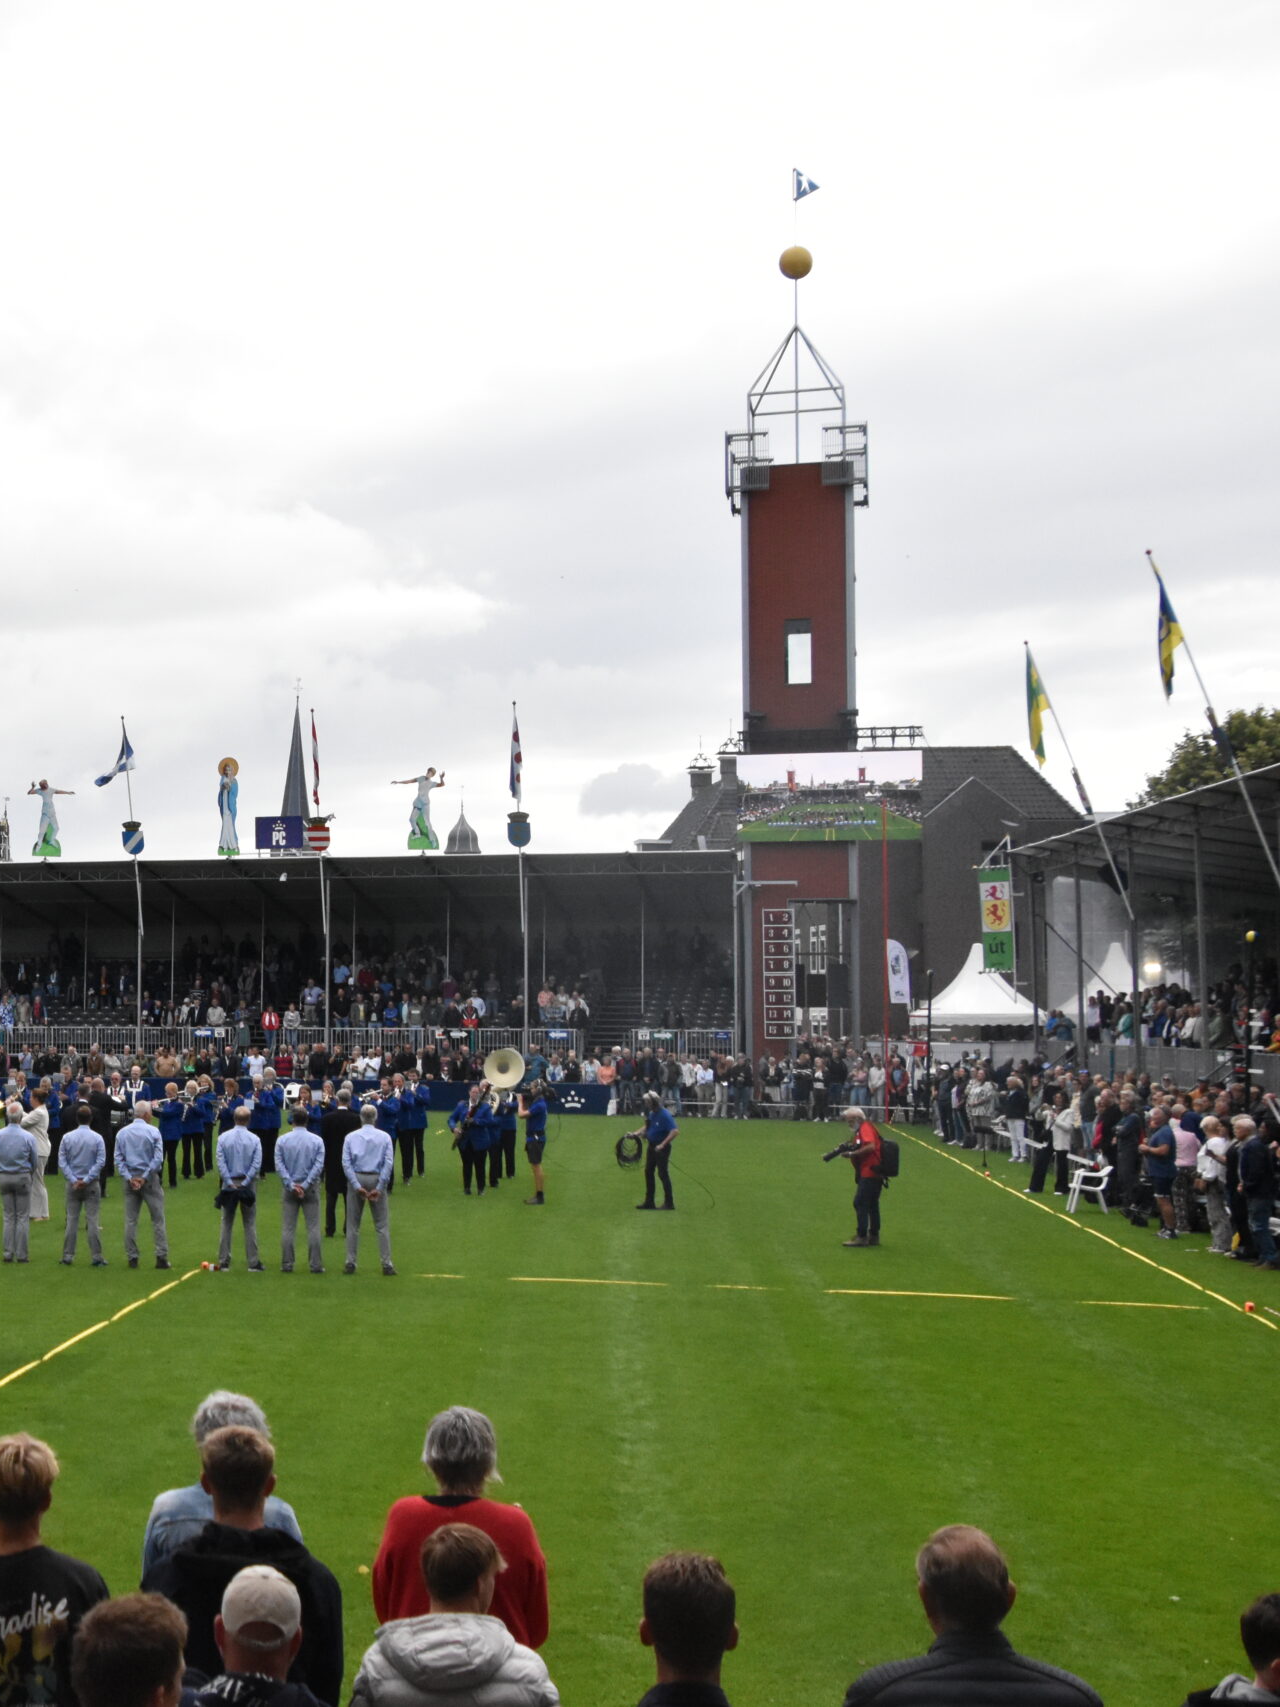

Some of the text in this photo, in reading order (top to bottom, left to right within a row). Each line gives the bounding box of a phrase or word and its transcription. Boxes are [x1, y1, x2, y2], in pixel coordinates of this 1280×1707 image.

[272, 830, 286, 846] PC
[989, 937, 1006, 954] út
[783, 978, 791, 987] 10
[769, 994, 791, 1002] 11 12
[783, 1010, 791, 1018] 14
[769, 1025, 792, 1034] 15 16
